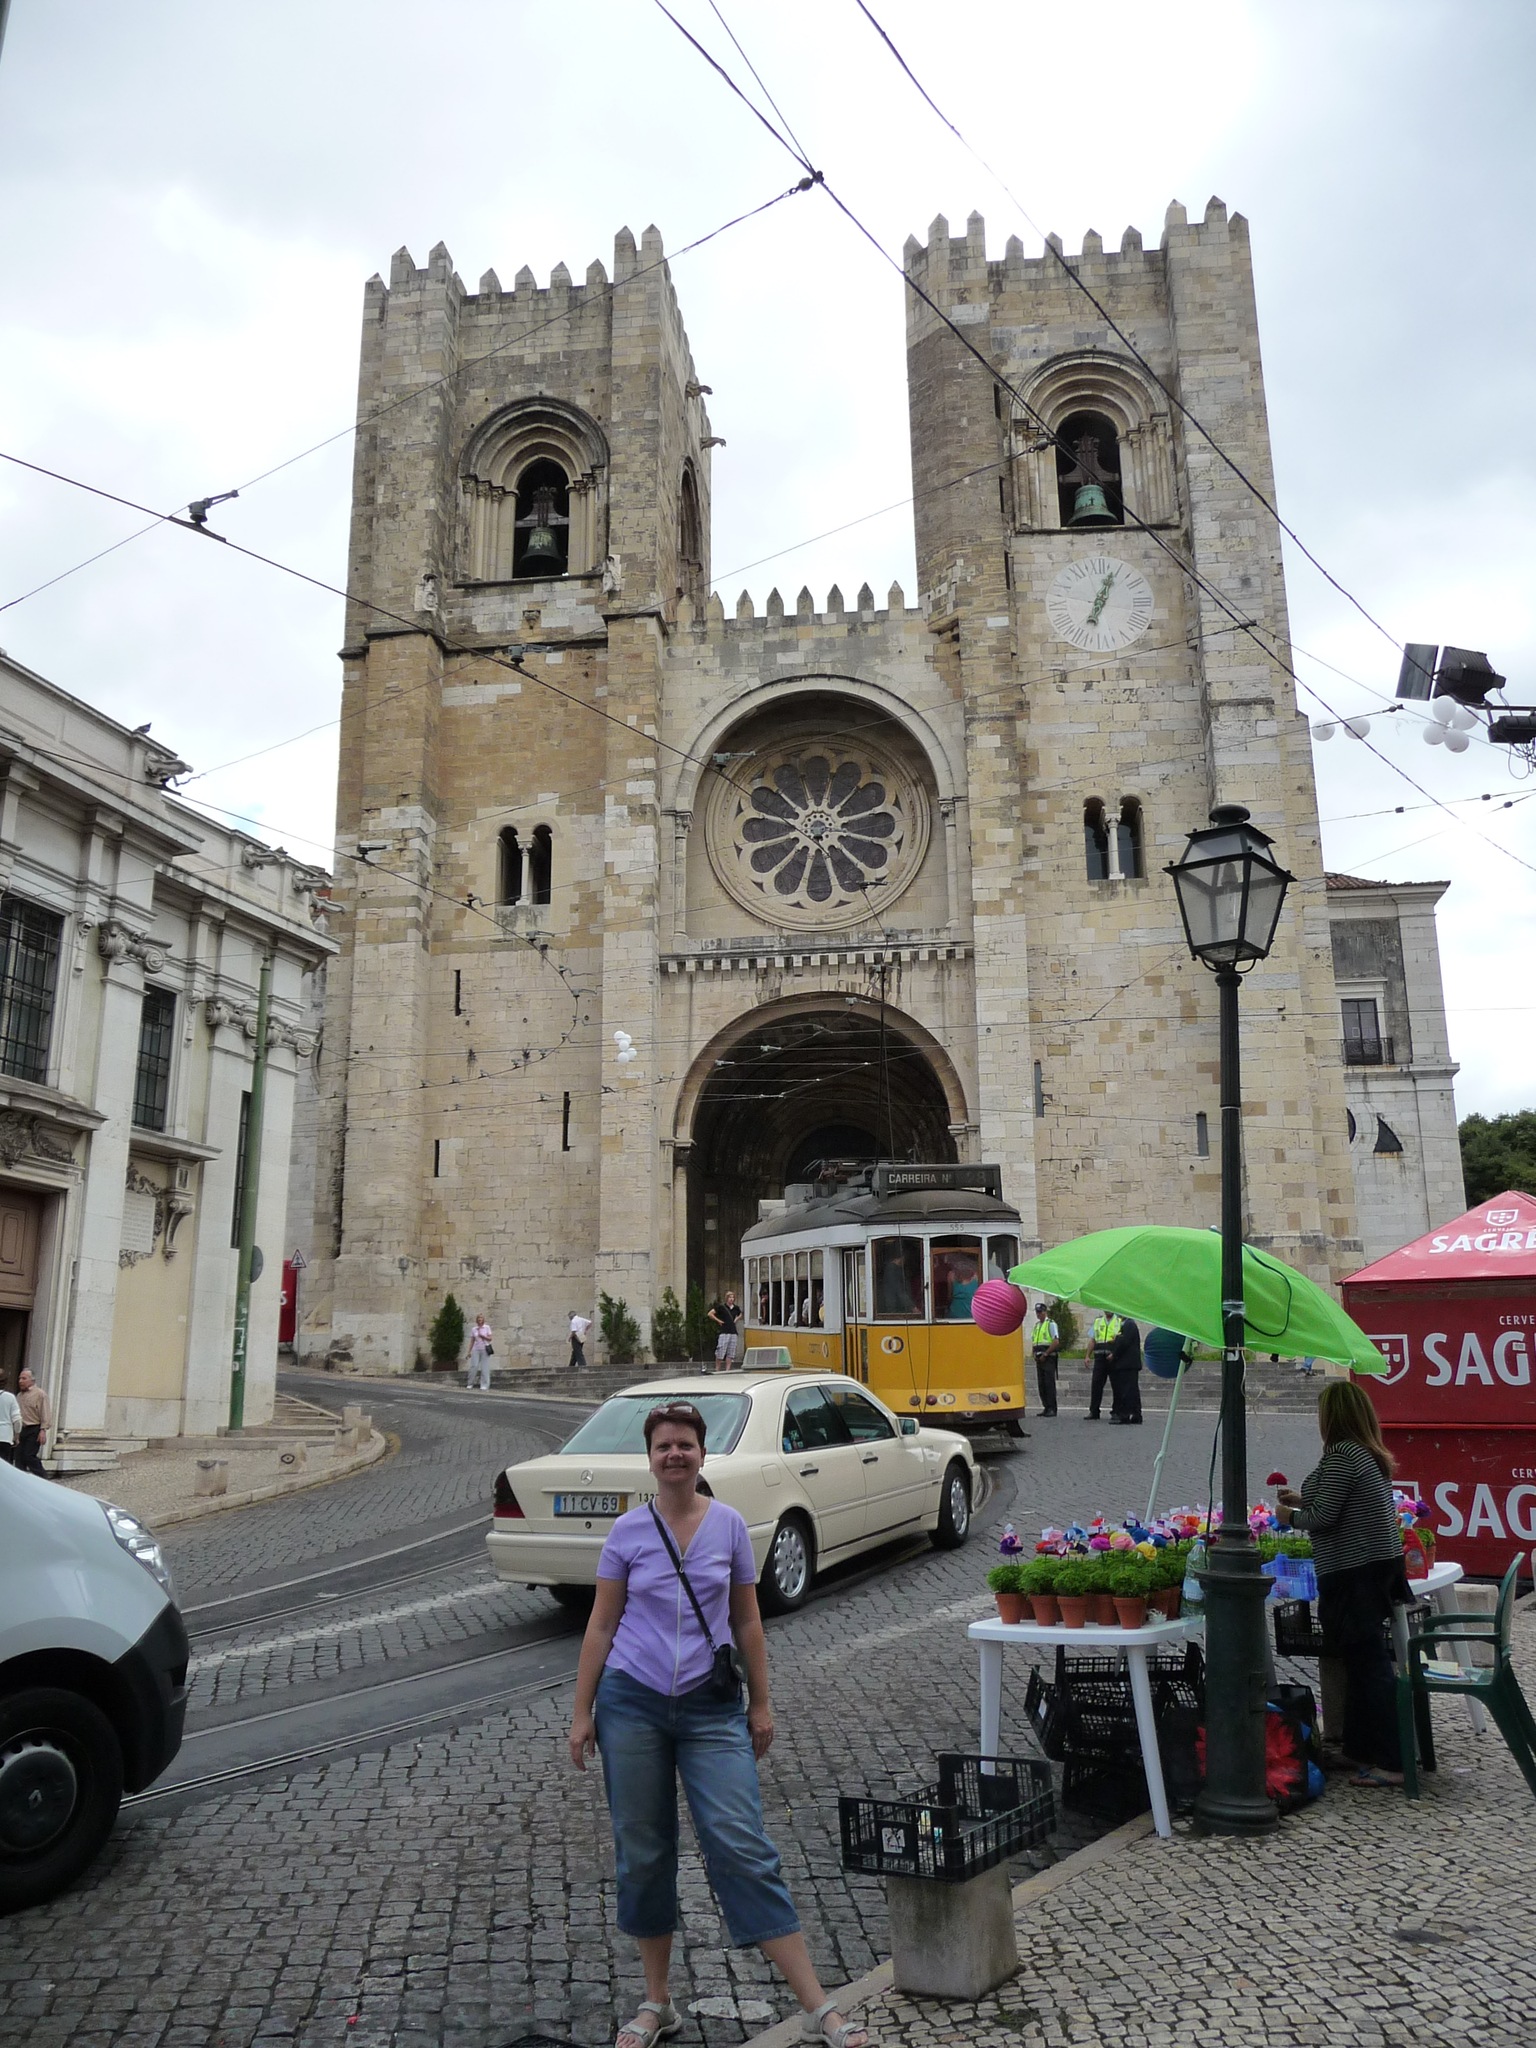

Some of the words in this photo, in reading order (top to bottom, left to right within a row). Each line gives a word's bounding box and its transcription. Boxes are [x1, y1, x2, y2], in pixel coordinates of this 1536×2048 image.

[1068, 563, 1086, 581] XI
[1090, 559, 1105, 574] XII
[1115, 563, 1124, 577] I
[1053, 580, 1071, 592] X
[1126, 577, 1144, 590] II
[1049, 600, 1067, 611] IX
[1133, 597, 1152, 607] III
[1126, 612, 1149, 630] IIII
[888, 1173, 937, 1184] CARREIRA
[1499, 1315, 1535, 1325] CERVE
[1423, 1331, 1536, 1386] SAG
[1512, 1468, 1536, 1478] CER
